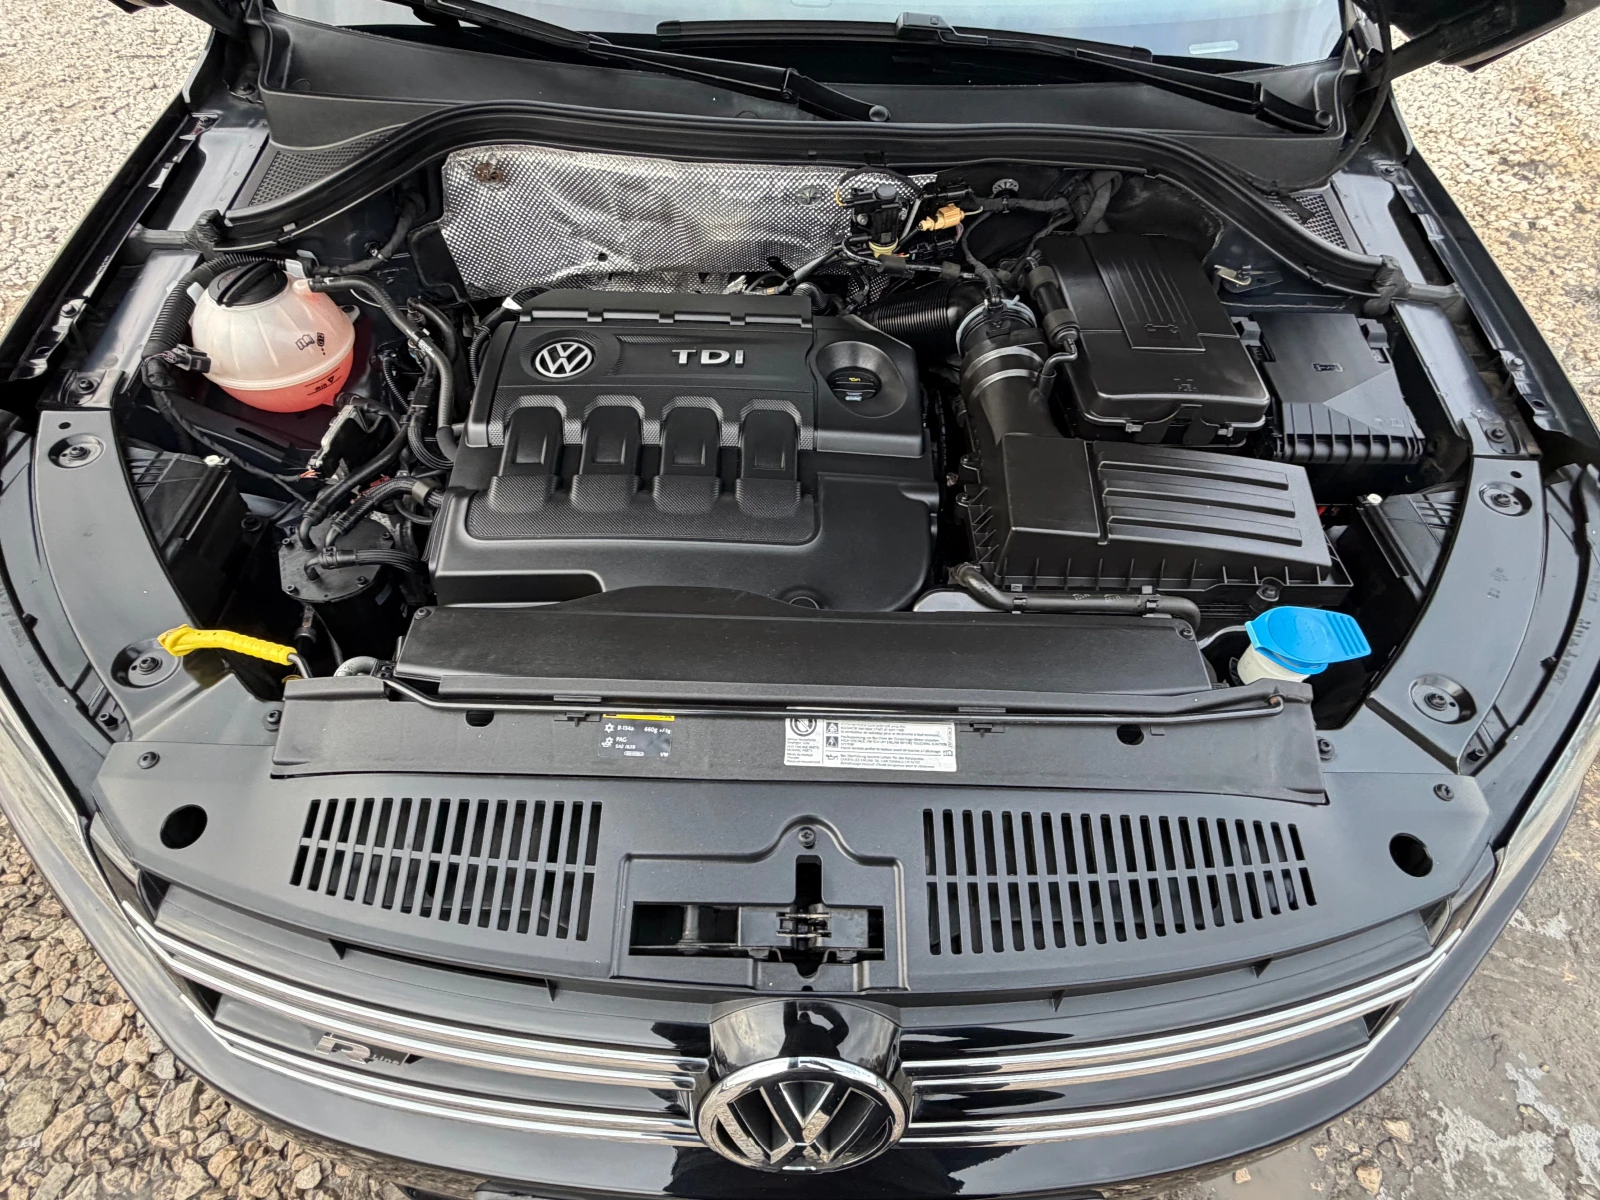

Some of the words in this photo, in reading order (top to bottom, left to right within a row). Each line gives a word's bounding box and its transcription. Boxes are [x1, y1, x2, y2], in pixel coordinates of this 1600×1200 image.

[535, 341, 593, 378] VW
[671, 349, 746, 366] TDI
[698, 1057, 908, 1172] VW
